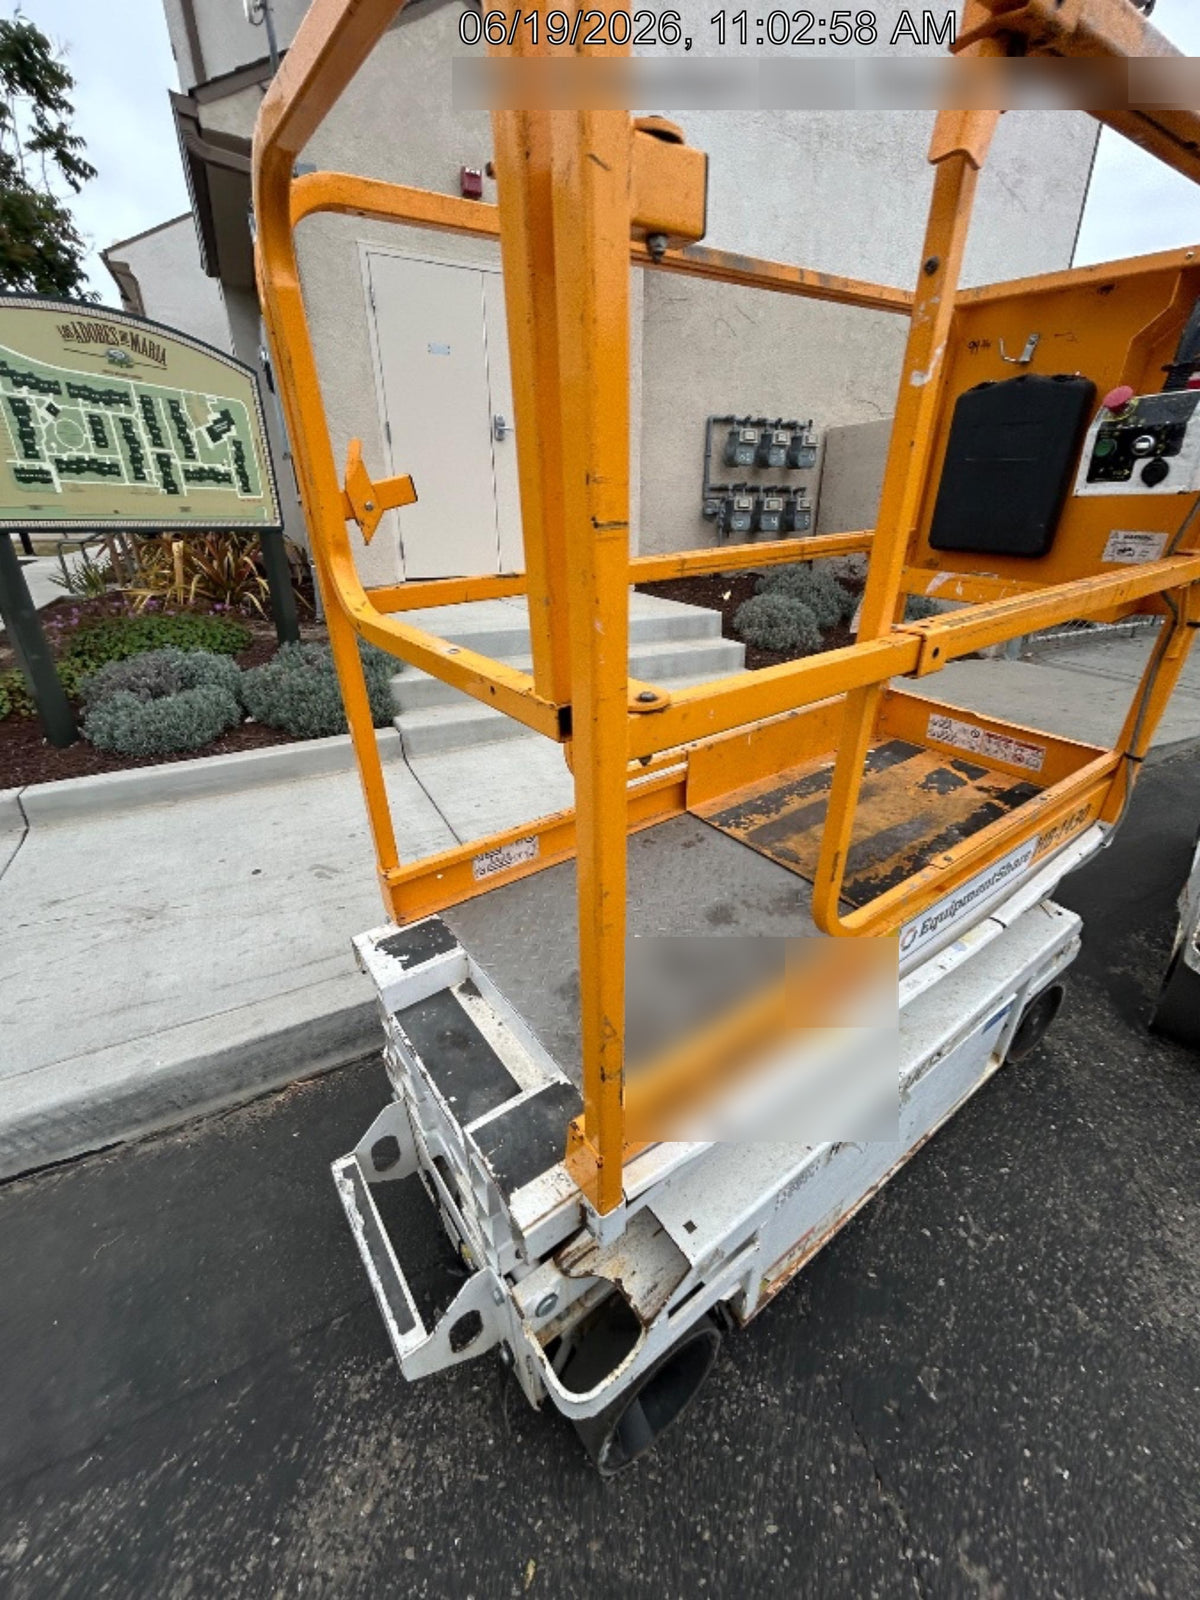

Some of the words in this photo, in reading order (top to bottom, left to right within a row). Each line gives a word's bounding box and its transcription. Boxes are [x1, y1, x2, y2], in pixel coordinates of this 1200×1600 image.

[71, 321, 120, 347] ADOBES
[130, 331, 168, 366] MARIA
[918, 849, 1033, 938] EquipmentShare
